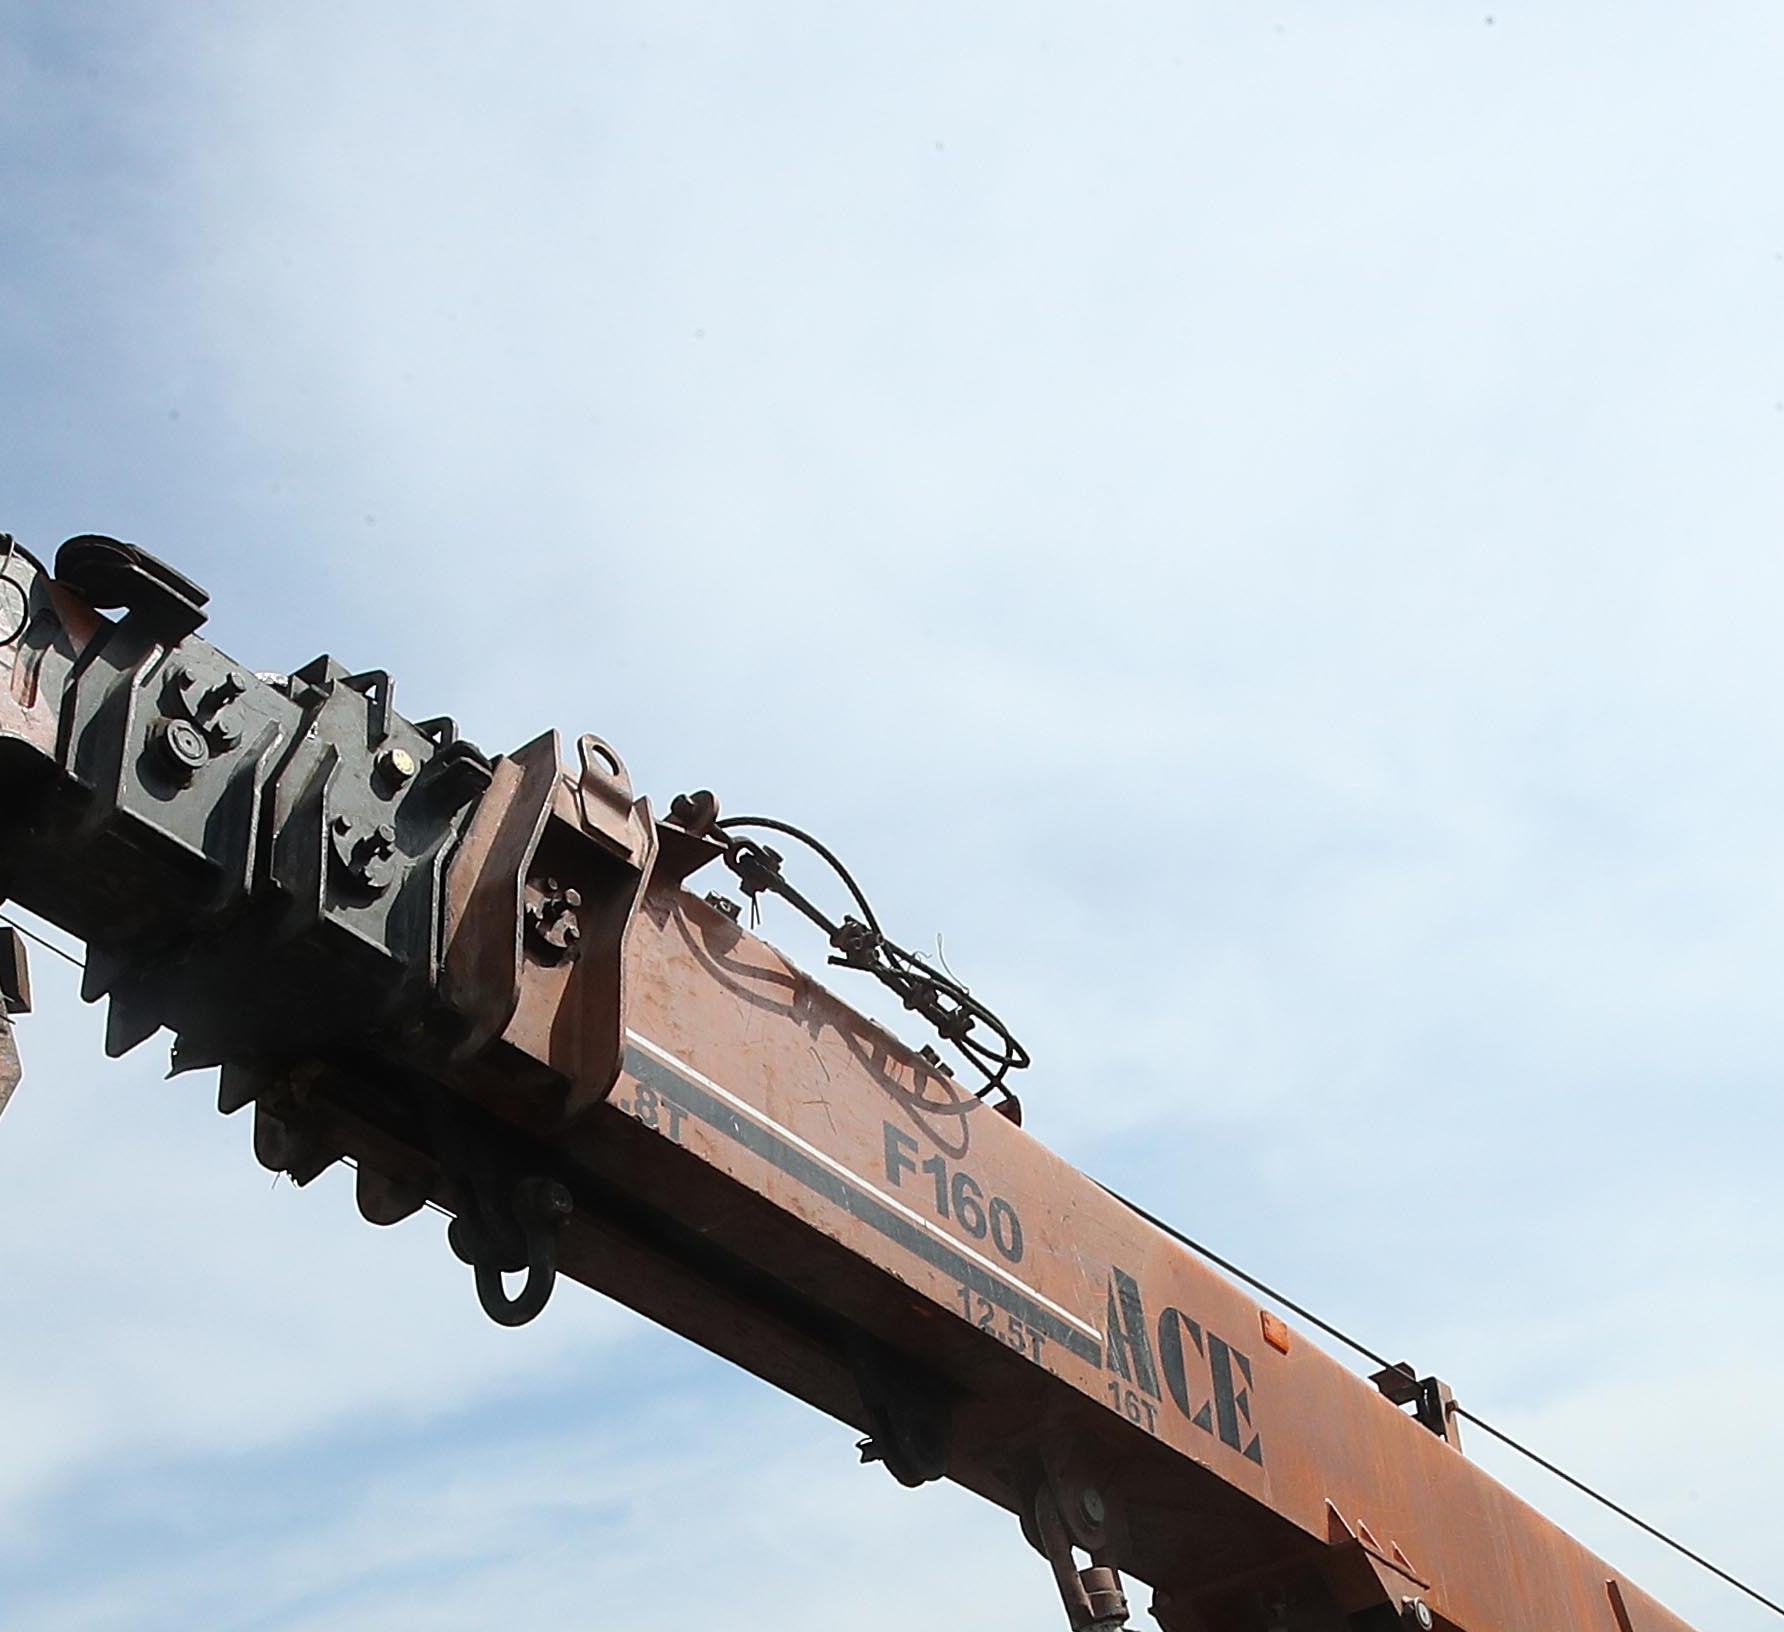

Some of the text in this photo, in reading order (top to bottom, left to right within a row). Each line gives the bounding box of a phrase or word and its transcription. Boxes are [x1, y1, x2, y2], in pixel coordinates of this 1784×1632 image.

[882, 1119, 1024, 1264] F160
[956, 1284, 1047, 1366] 12.5T
[1105, 1265, 1264, 1467] ACE
[1106, 1379, 1158, 1434] 16T
